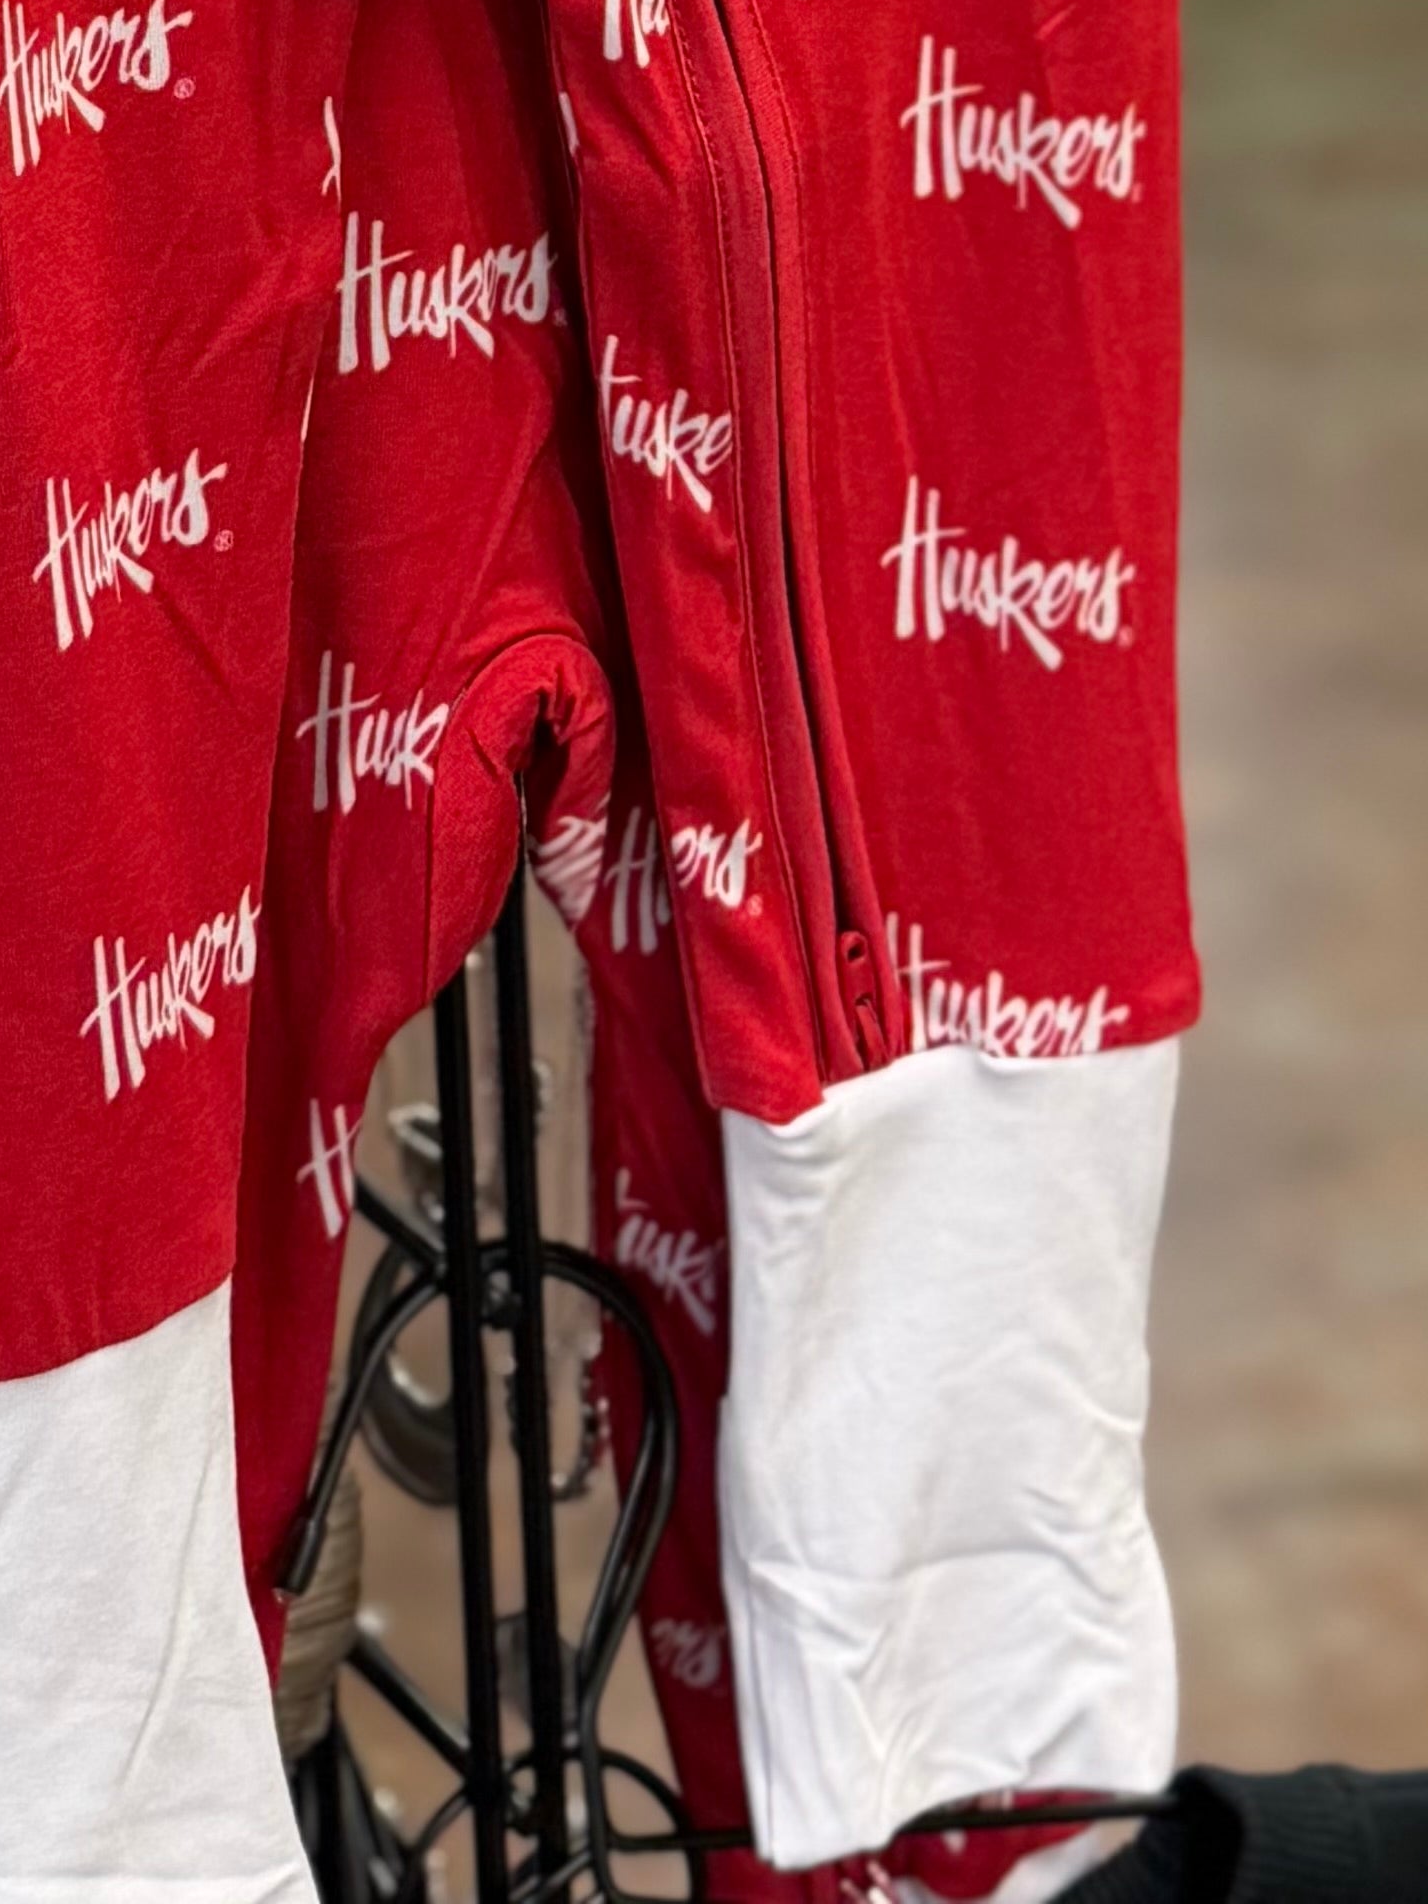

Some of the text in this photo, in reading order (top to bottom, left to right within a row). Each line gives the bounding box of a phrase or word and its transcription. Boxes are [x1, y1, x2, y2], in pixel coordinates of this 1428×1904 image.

[899, 34, 1147, 230] Huskers
[335, 210, 553, 375] Huskers
[31, 447, 228, 653] Huskers
[880, 474, 1137, 672] Huskers
[295, 650, 451, 816] Husk
[78, 884, 263, 1102] Huskers
